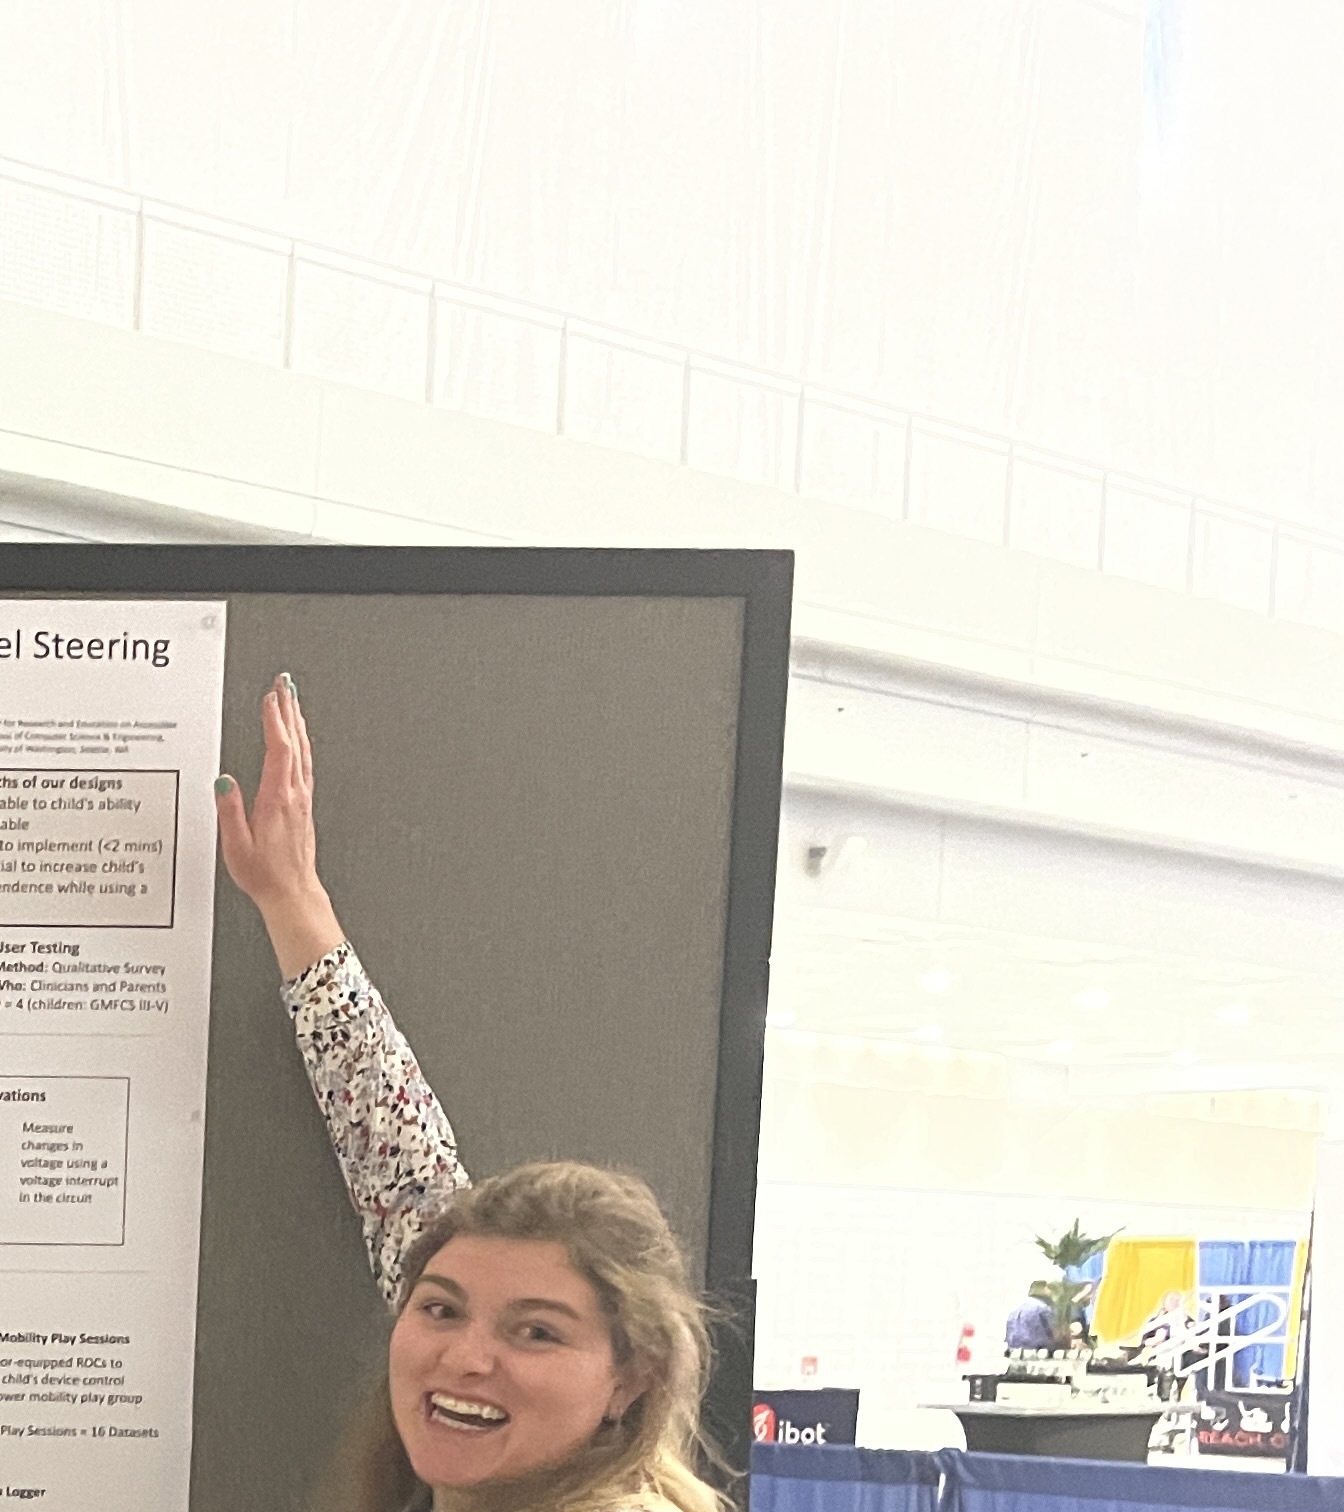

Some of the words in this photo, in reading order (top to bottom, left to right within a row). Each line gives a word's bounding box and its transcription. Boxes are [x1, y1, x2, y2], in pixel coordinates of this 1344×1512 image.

[33, 632, 170, 667] Steering
[22, 775, 37, 789] of
[40, 779, 65, 789] our
[69, 776, 122, 792] designs
[32, 798, 46, 810] to
[98, 797, 140, 813] ability
[21, 861, 35, 873] to
[39, 861, 97, 873] increase
[57, 880, 95, 896] while
[99, 884, 135, 897] using
[140, 884, 147, 894] a
[30, 941, 79, 957] Testing
[778, 1420, 827, 1445] ibot
